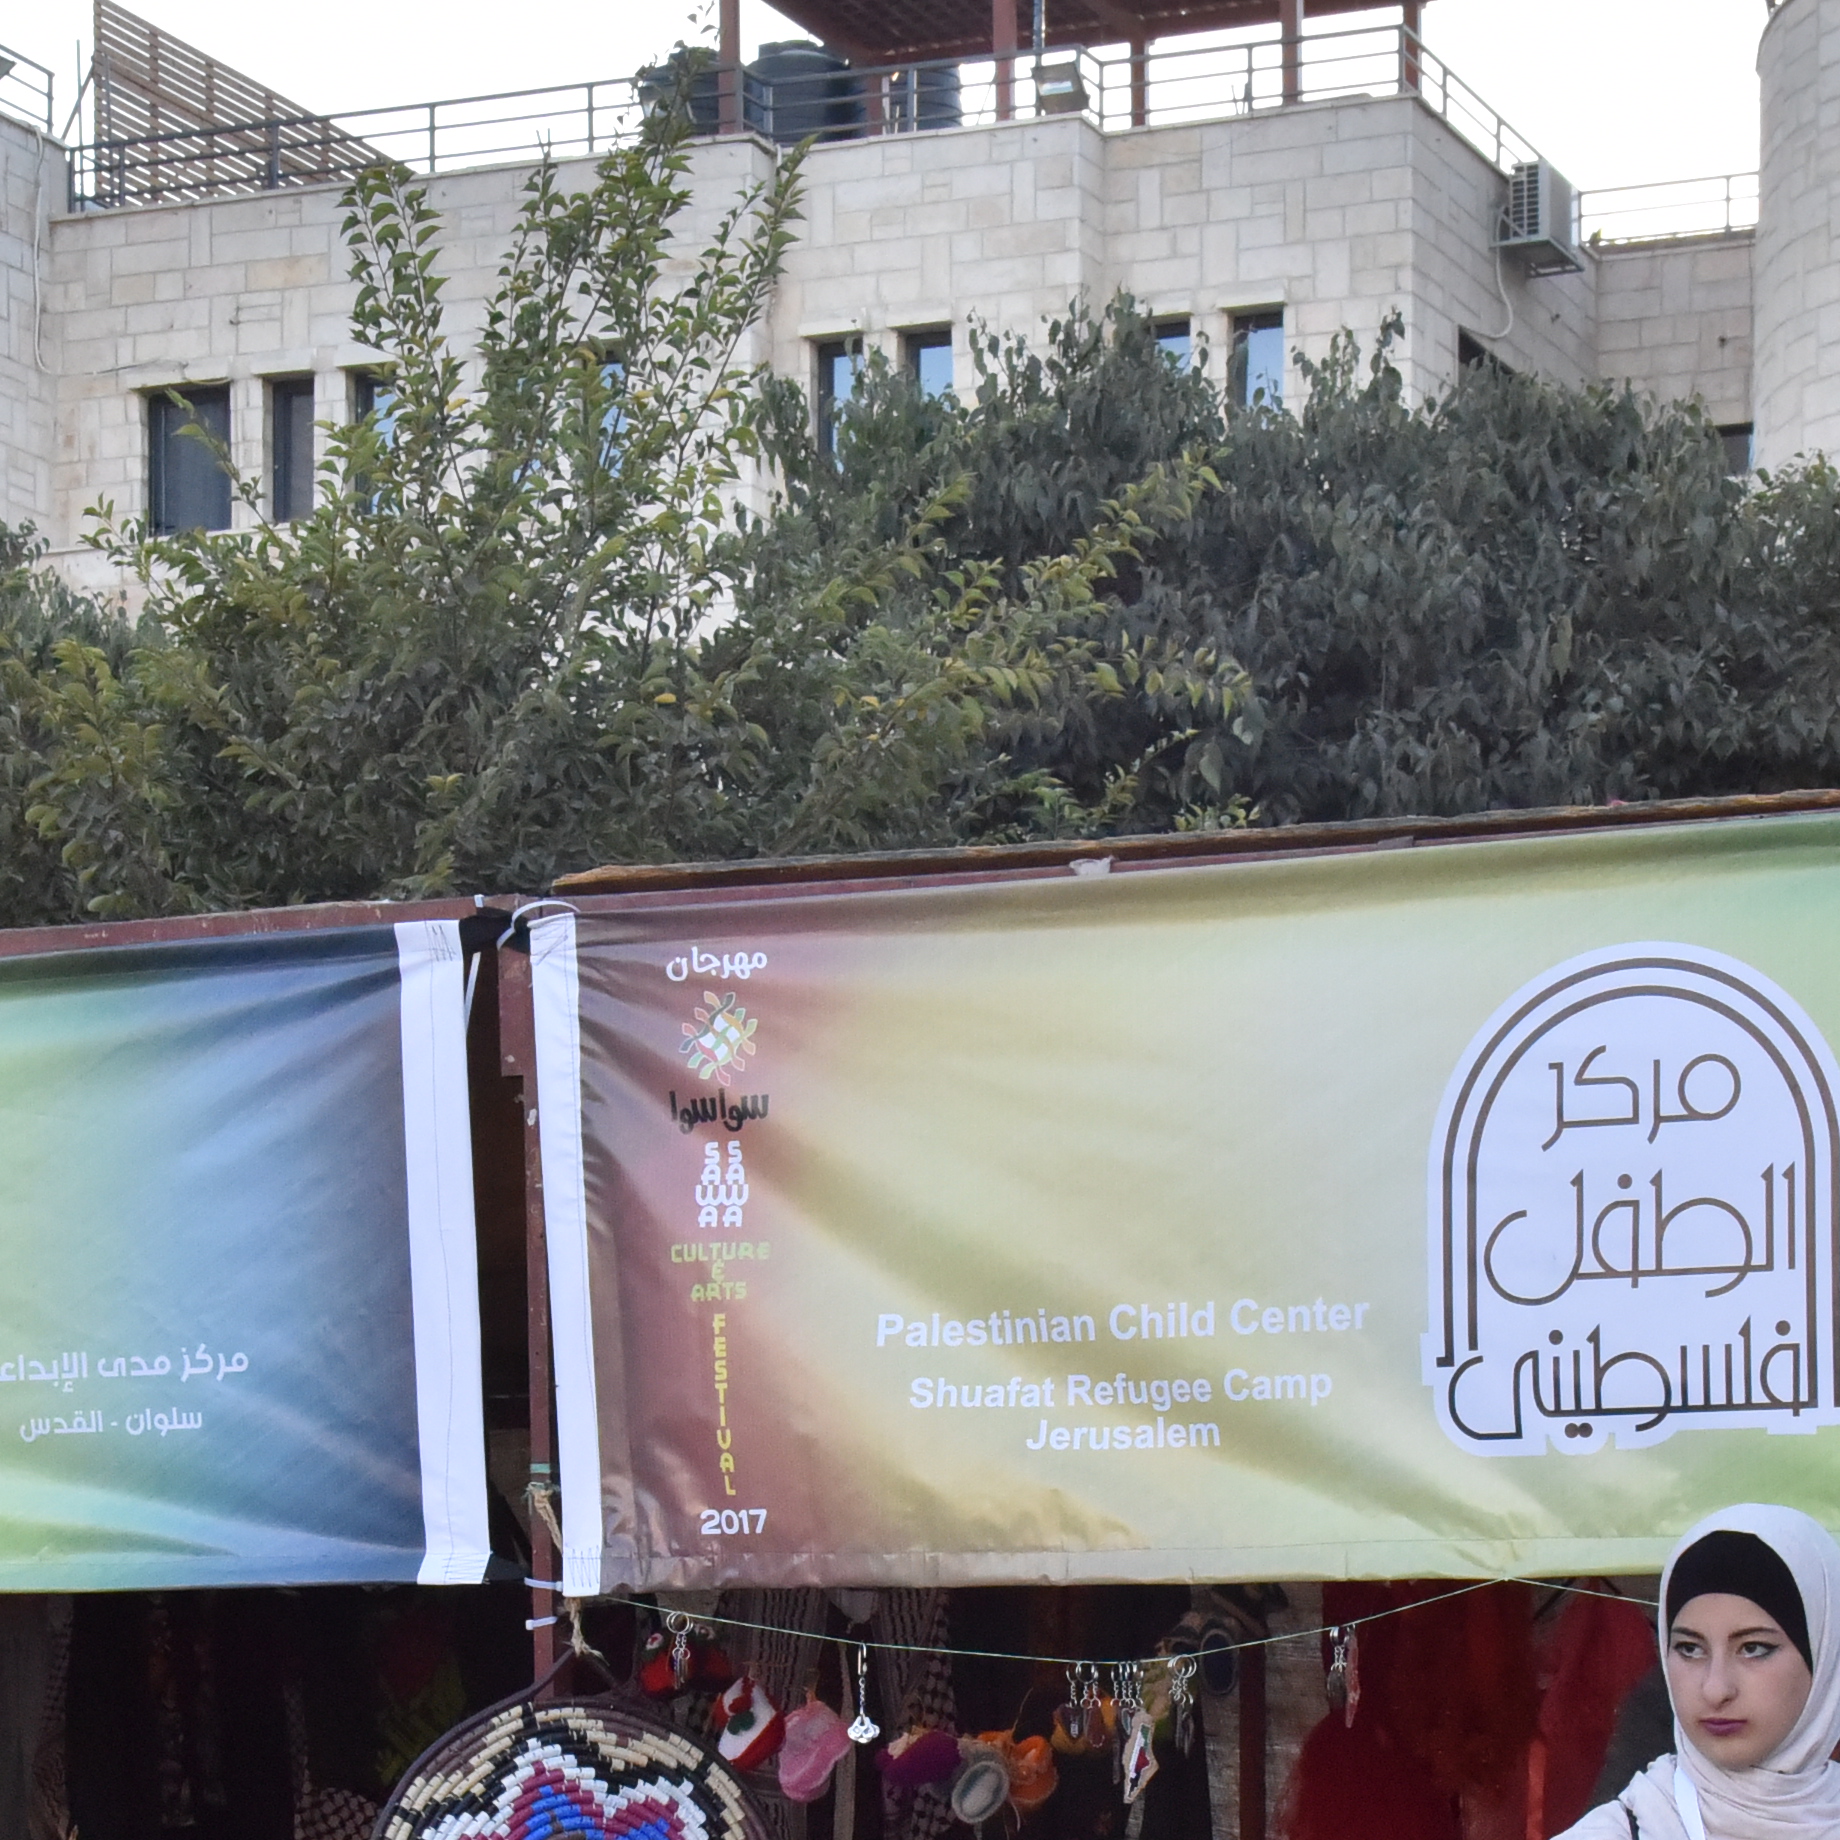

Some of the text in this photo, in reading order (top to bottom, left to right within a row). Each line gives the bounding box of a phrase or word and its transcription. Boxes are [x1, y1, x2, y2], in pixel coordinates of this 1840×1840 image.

[666, 946, 768, 982] مهرجان
[1483, 1160, 1797, 1307] الطفل
[670, 1242, 771, 1263] CULTURE
[690, 1281, 748, 1302] ARTS
[876, 1296, 1369, 1348] Palestinian Child Center
[97, 1354, 171, 1377] مدى
[180, 1343, 250, 1383] مركز
[909, 1367, 1333, 1412] Shuafat Refugee Camp
[20, 1409, 103, 1443] القدس
[125, 1407, 203, 1437] سلوان
[1026, 1416, 1221, 1451] Jerusalem
[700, 1508, 768, 1535] 2017
